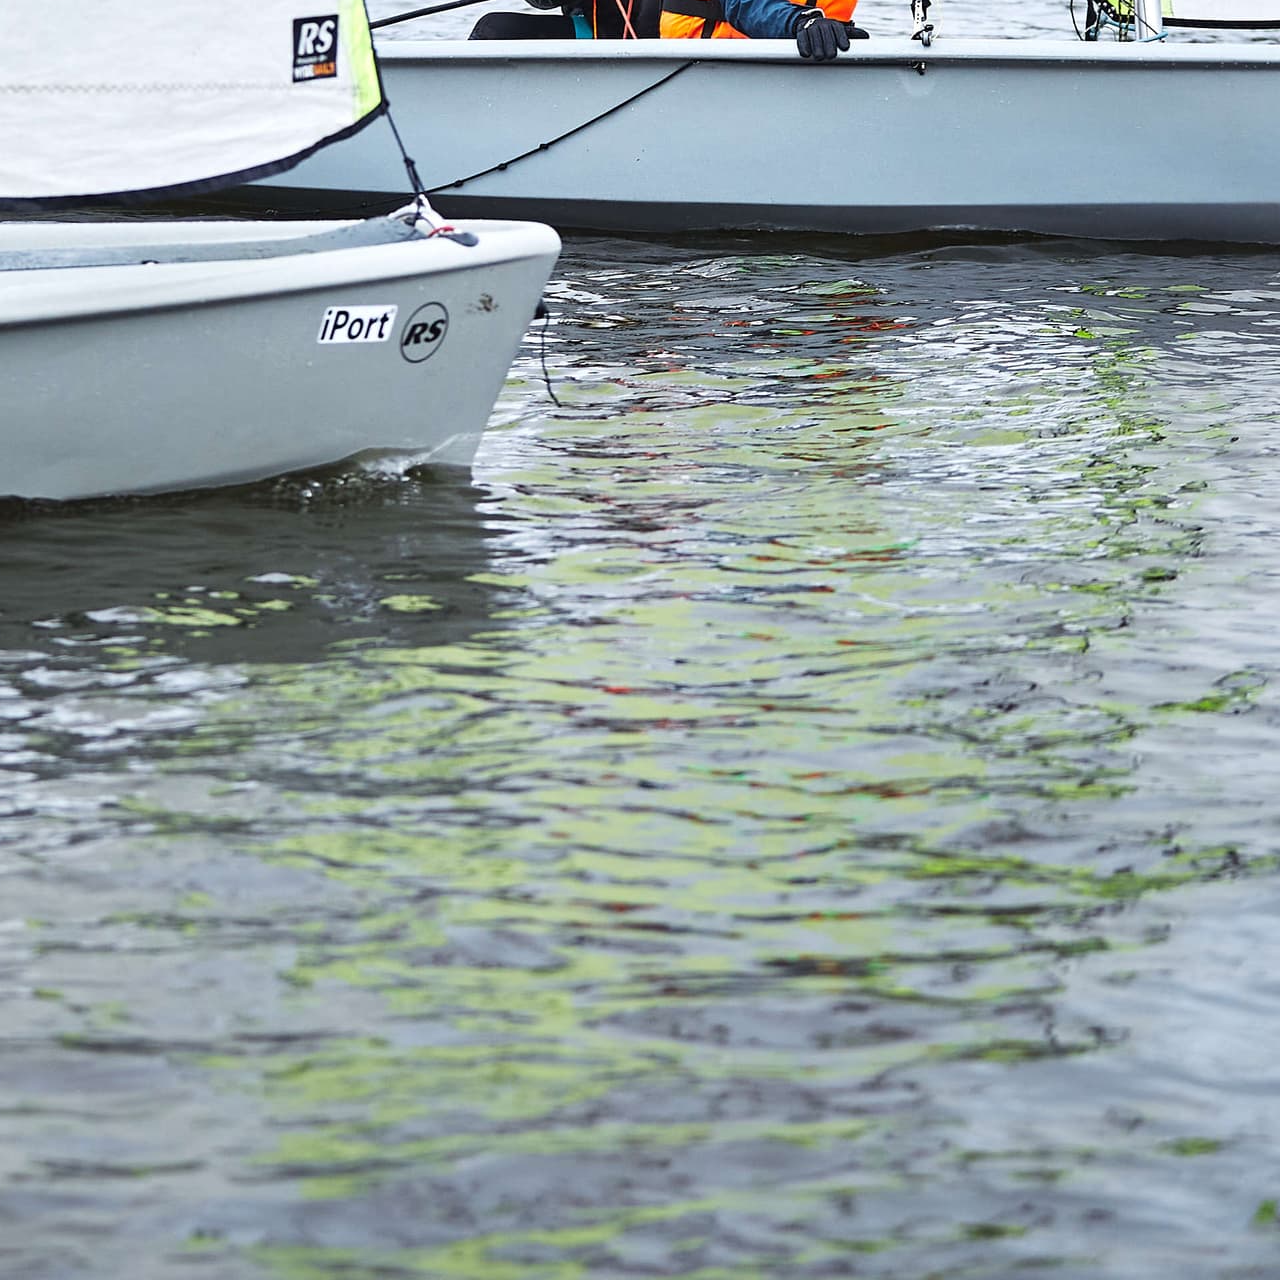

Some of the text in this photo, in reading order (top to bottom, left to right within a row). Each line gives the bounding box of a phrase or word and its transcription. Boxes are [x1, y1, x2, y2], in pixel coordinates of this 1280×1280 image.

[298, 20, 335, 56] RS
[320, 310, 389, 340] iPort
[402, 319, 446, 346] RS
